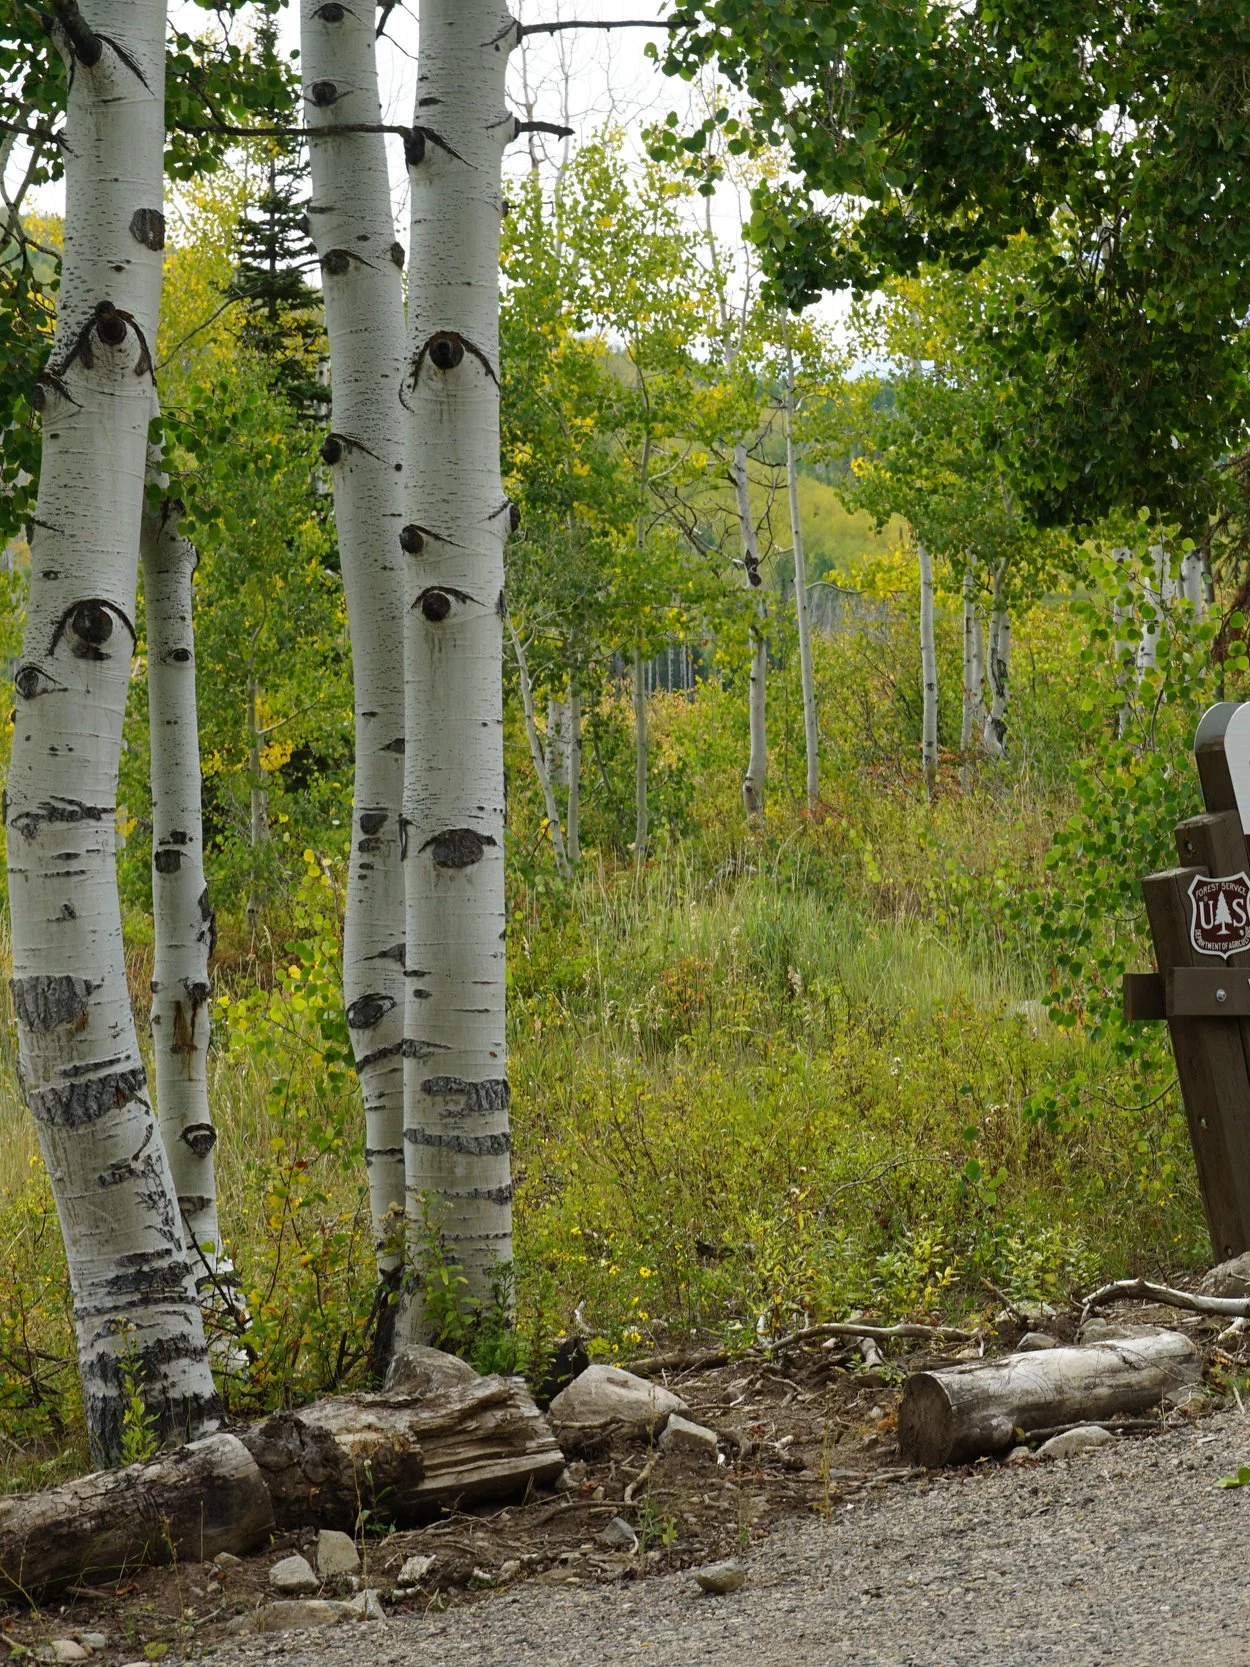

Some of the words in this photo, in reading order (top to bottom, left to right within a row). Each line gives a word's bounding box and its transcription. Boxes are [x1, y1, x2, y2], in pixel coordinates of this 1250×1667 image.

[1195, 883, 1219, 899] FOREST
[1221, 882, 1246, 896] SERVICE
[1222, 942, 1228, 950] OF
